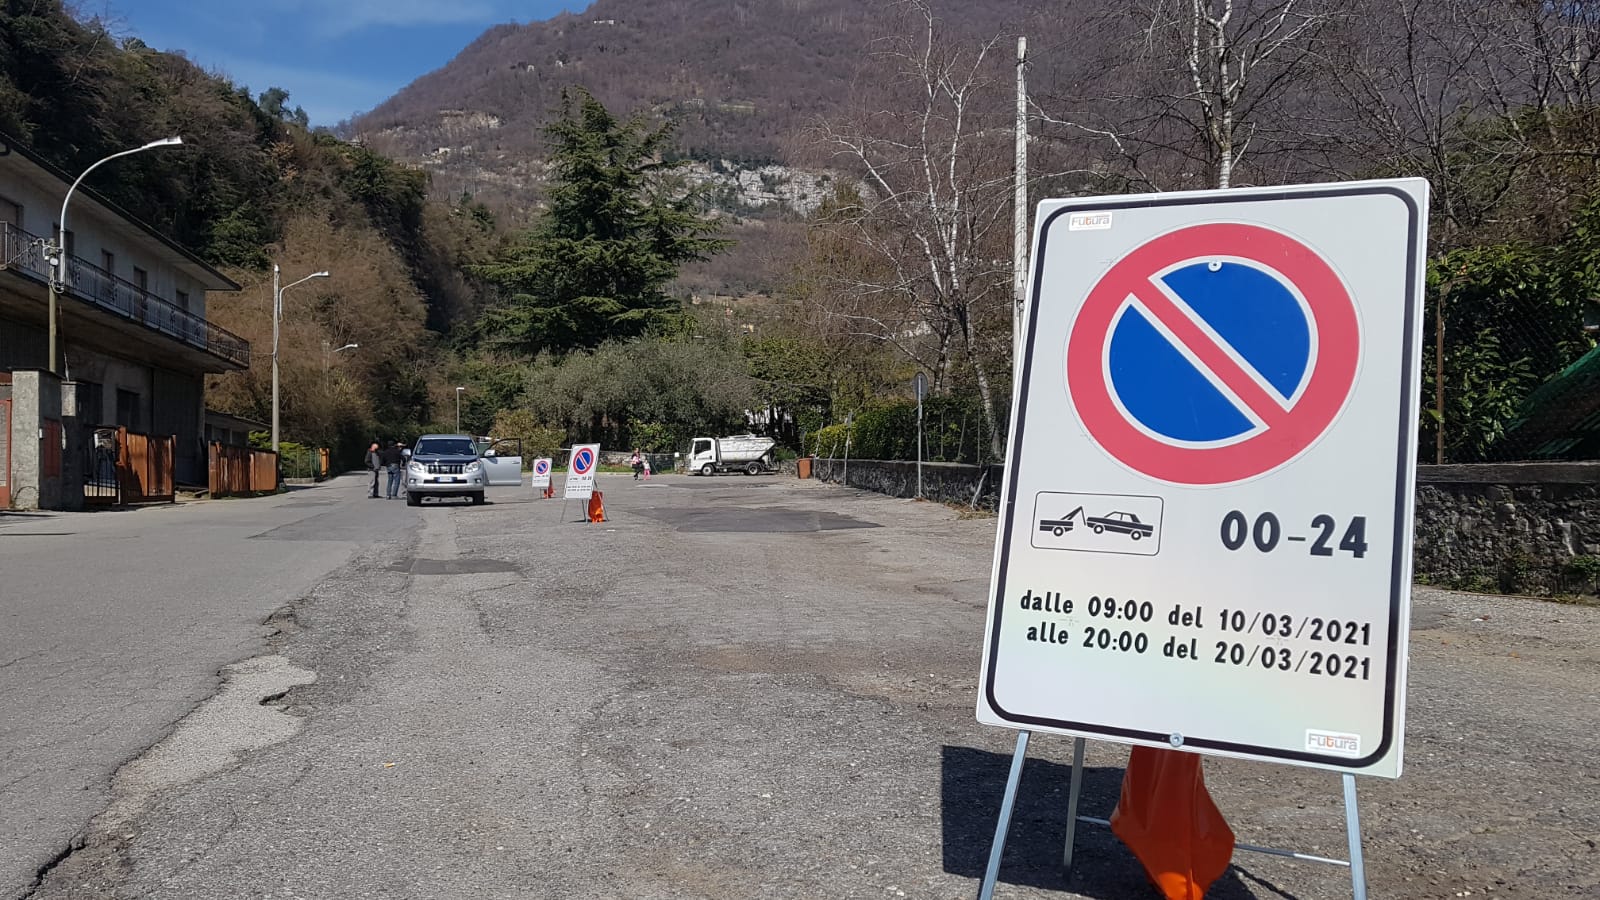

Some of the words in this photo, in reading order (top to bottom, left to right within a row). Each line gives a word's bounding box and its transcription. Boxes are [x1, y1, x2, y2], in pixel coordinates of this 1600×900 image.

[1071, 215, 1110, 226] Futura
[1220, 510, 1368, 558] 00-24
[1020, 590, 1074, 614] dalle
[1088, 596, 1154, 623] 09:00
[1168, 605, 1203, 629] del
[1219, 609, 1372, 646] 10/03/2021
[1026, 622, 1069, 645] alle
[1083, 627, 1148, 654] 20:00
[1163, 637, 1198, 661] del
[1214, 641, 1371, 681] 20/03/2021
[1308, 733, 1357, 750] Futura
